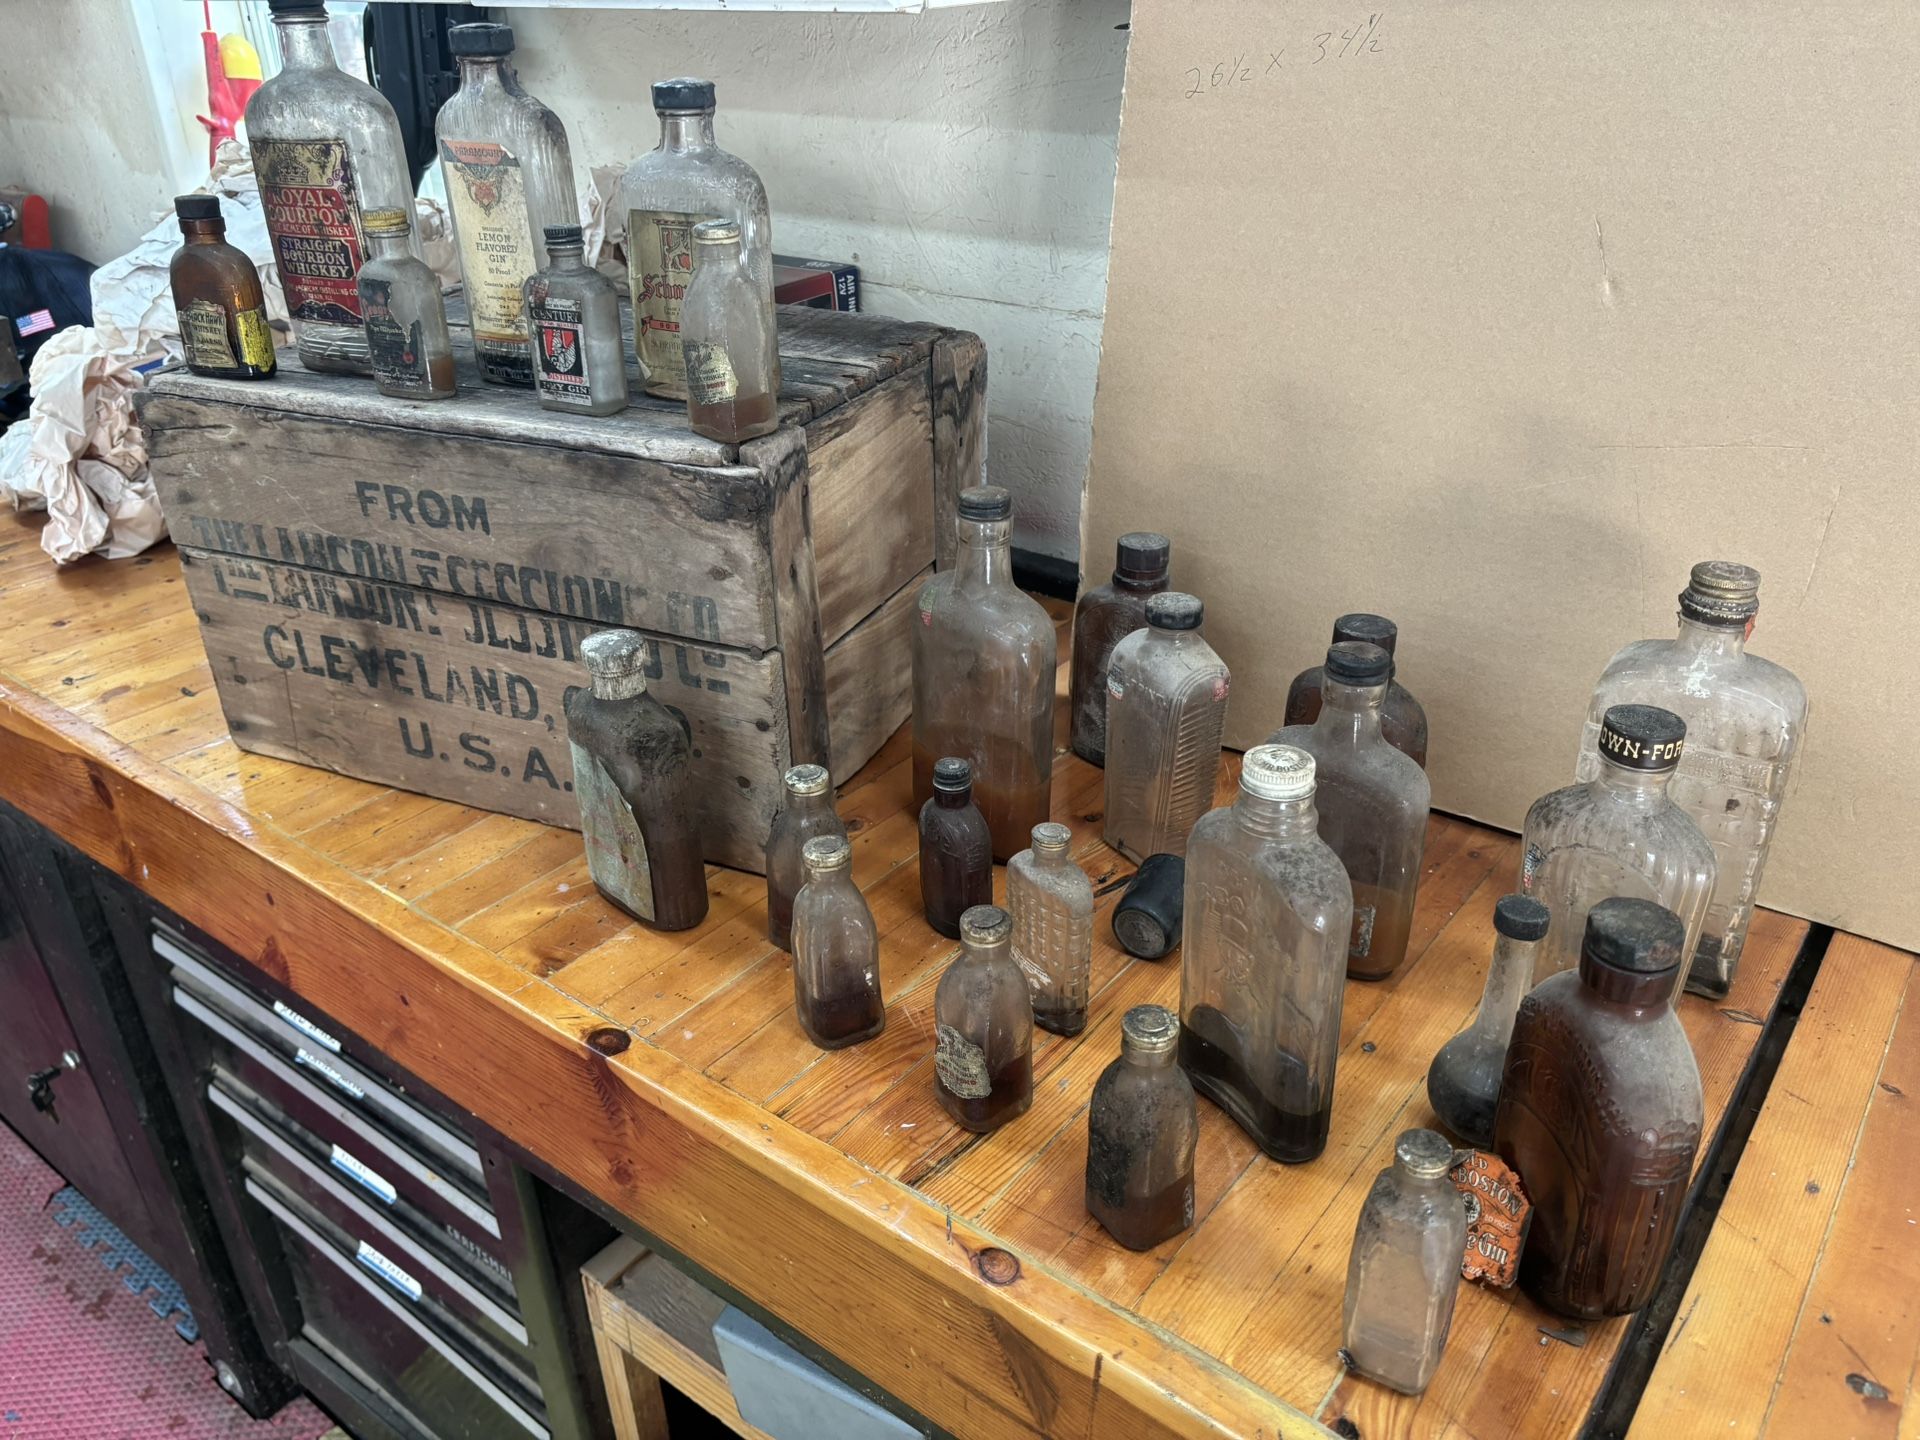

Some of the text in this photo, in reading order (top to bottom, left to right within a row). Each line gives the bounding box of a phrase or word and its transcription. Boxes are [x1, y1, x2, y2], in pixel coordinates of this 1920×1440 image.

[455, 147, 504, 158] PARAMOUNT
[281, 238, 342, 252] STRAIGHT
[478, 232, 512, 243] LEMON
[476, 242, 518, 254] FLAVORED
[283, 249, 347, 266] BOURBON
[489, 254, 507, 264] GIN
[285, 261, 350, 278] WHISKEY
[837, 276, 847, 295] 12V
[845, 274, 856, 295] AIR
[531, 309, 579, 323] CENTURY
[548, 372, 584, 384] DISTILLED
[567, 384, 589, 395] GIN
[354, 480, 491, 536] FROM
[262, 624, 555, 733] CLEVELAND,
[398, 716, 574, 793] U.S.A.
[1457, 1167, 1523, 1217] BOSTON
[1477, 1231, 1509, 1266] Gin
